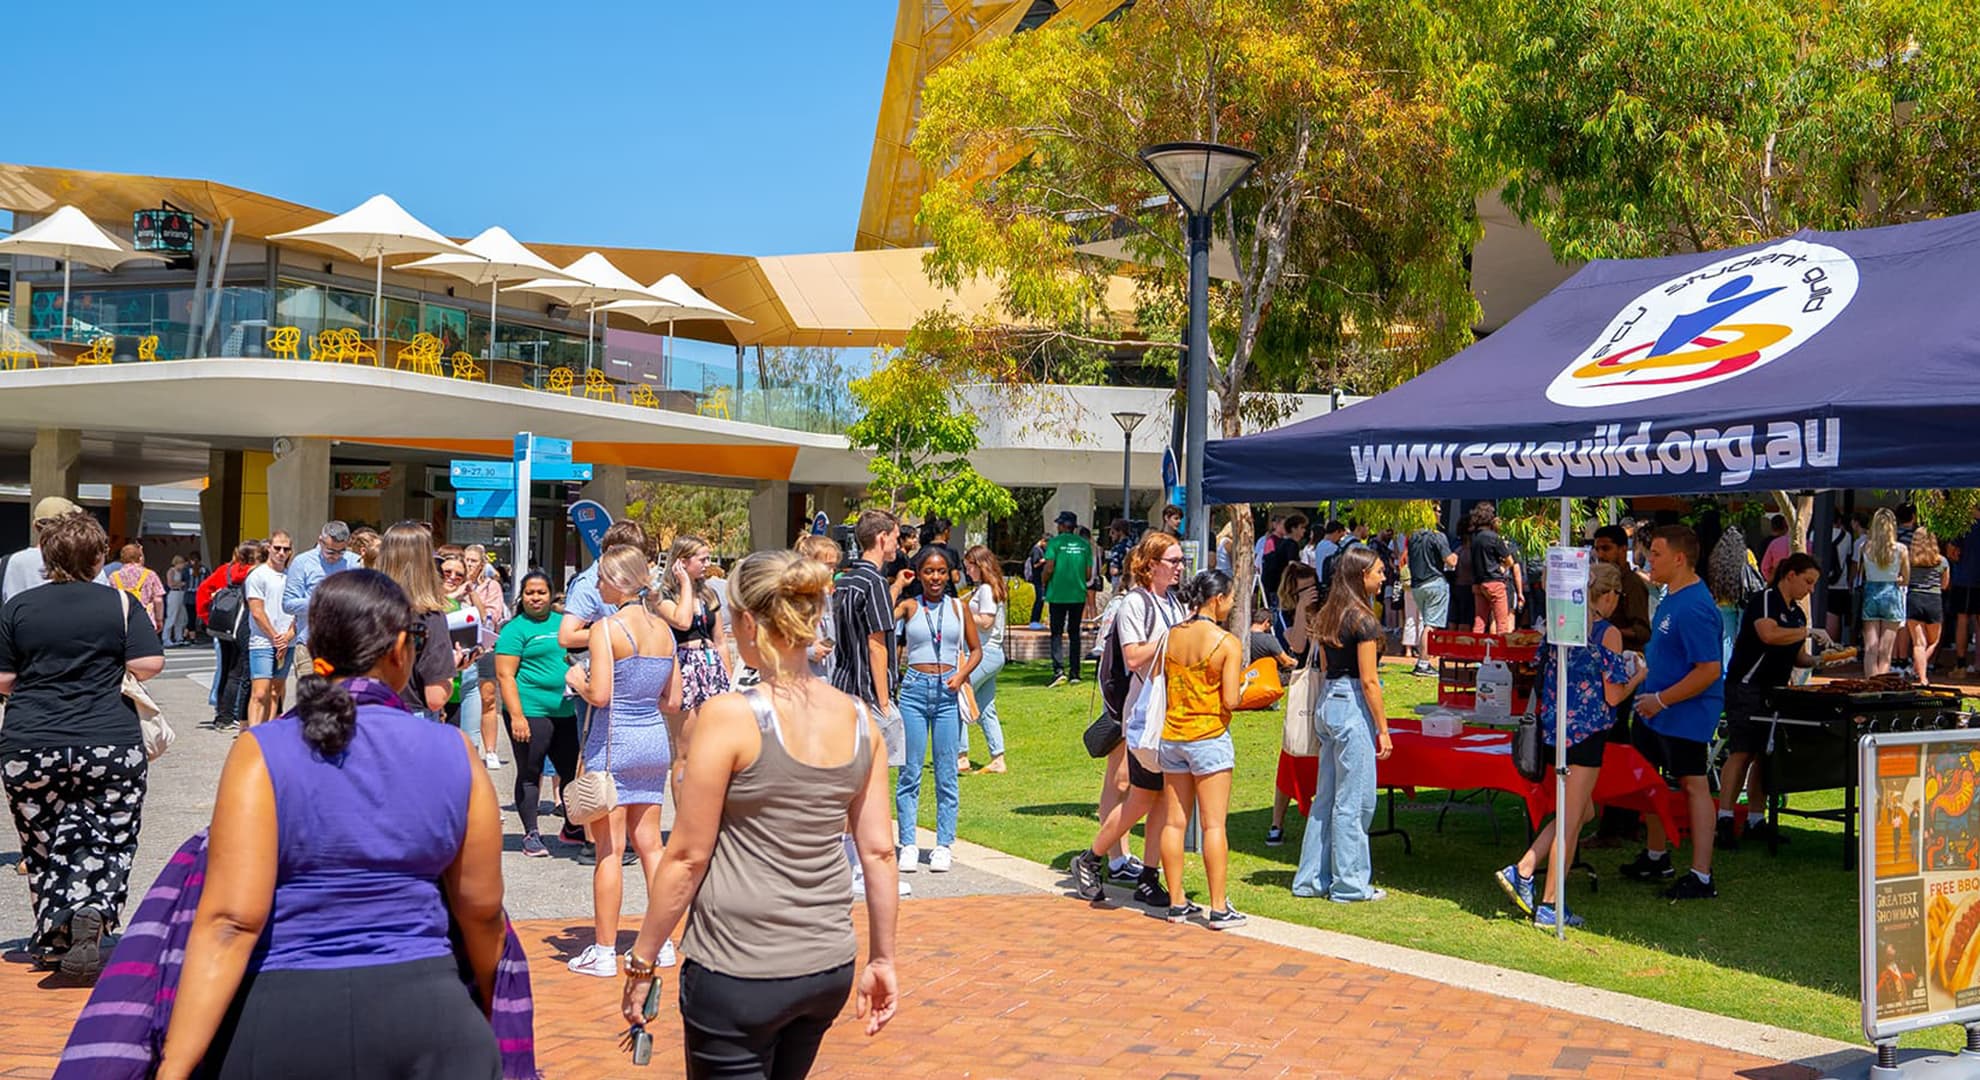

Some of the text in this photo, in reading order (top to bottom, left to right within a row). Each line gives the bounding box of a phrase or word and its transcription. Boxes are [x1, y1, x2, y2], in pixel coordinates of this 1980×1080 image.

[1592, 251, 1832, 359] ecu student guild
[1350, 417, 1840, 492] www.ecuguild.org.au
[1929, 877, 1980, 897] FREE BBQ
[1876, 891, 1918, 908] GREATEST
[1876, 906, 1920, 924] SHOWMAN
